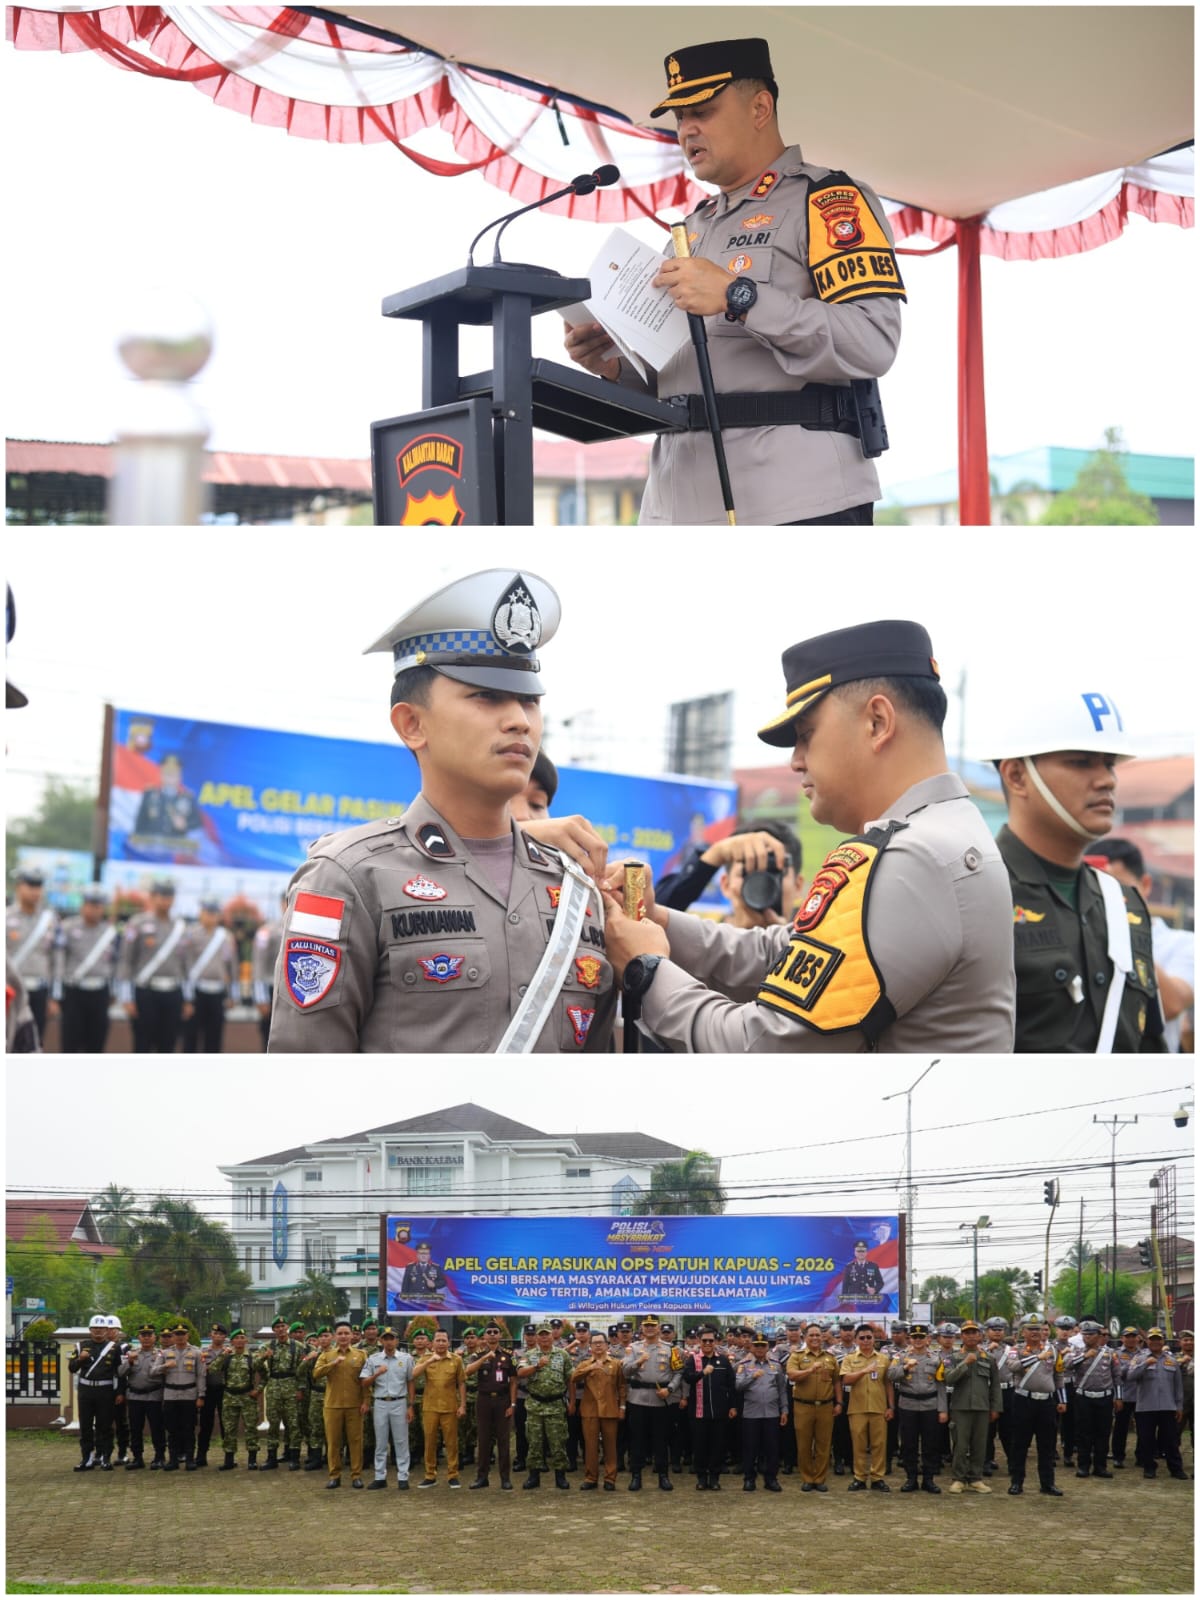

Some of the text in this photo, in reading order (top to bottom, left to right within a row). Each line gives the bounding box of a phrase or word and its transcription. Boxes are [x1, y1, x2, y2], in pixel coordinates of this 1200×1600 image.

[817, 190, 854, 204] POLRES
[726, 232, 771, 249] POLRI
[815, 255, 894, 294] KA OPS RES
[391, 910, 476, 939] KURNIAWAN
[290, 941, 335, 957] LALU LINTAS
[784, 950, 824, 988] RES
[397, 1155, 464, 1165] BANK KALBAR
[611, 1221, 649, 1231] POLISI
[607, 1233, 664, 1242] MASYARAKAT
[443, 1257, 482, 1271] APEL
[486, 1257, 538, 1271] GELAR
[542, 1257, 617, 1271] PASUKAN
[621, 1257, 654, 1271] OPS
[658, 1257, 709, 1271] PATUH
[714, 1257, 779, 1271] KAPUAS
[795, 1257, 834, 1271] 2026
[471, 1274, 811, 1285] POLISI BERSAMA MASYARAKAT MEWUJUDKAN LALU LINTAS
[514, 1287, 767, 1299] YANG TERTIB, AMAN DAN BERKESELAMATAN
[568, 1302, 576, 1310] di
[578, 1302, 609, 1311] Wilayah
[611, 1302, 636, 1310] Hukum
[663, 1302, 692, 1311] Kapuas
[694, 1302, 711, 1310] Hulu
